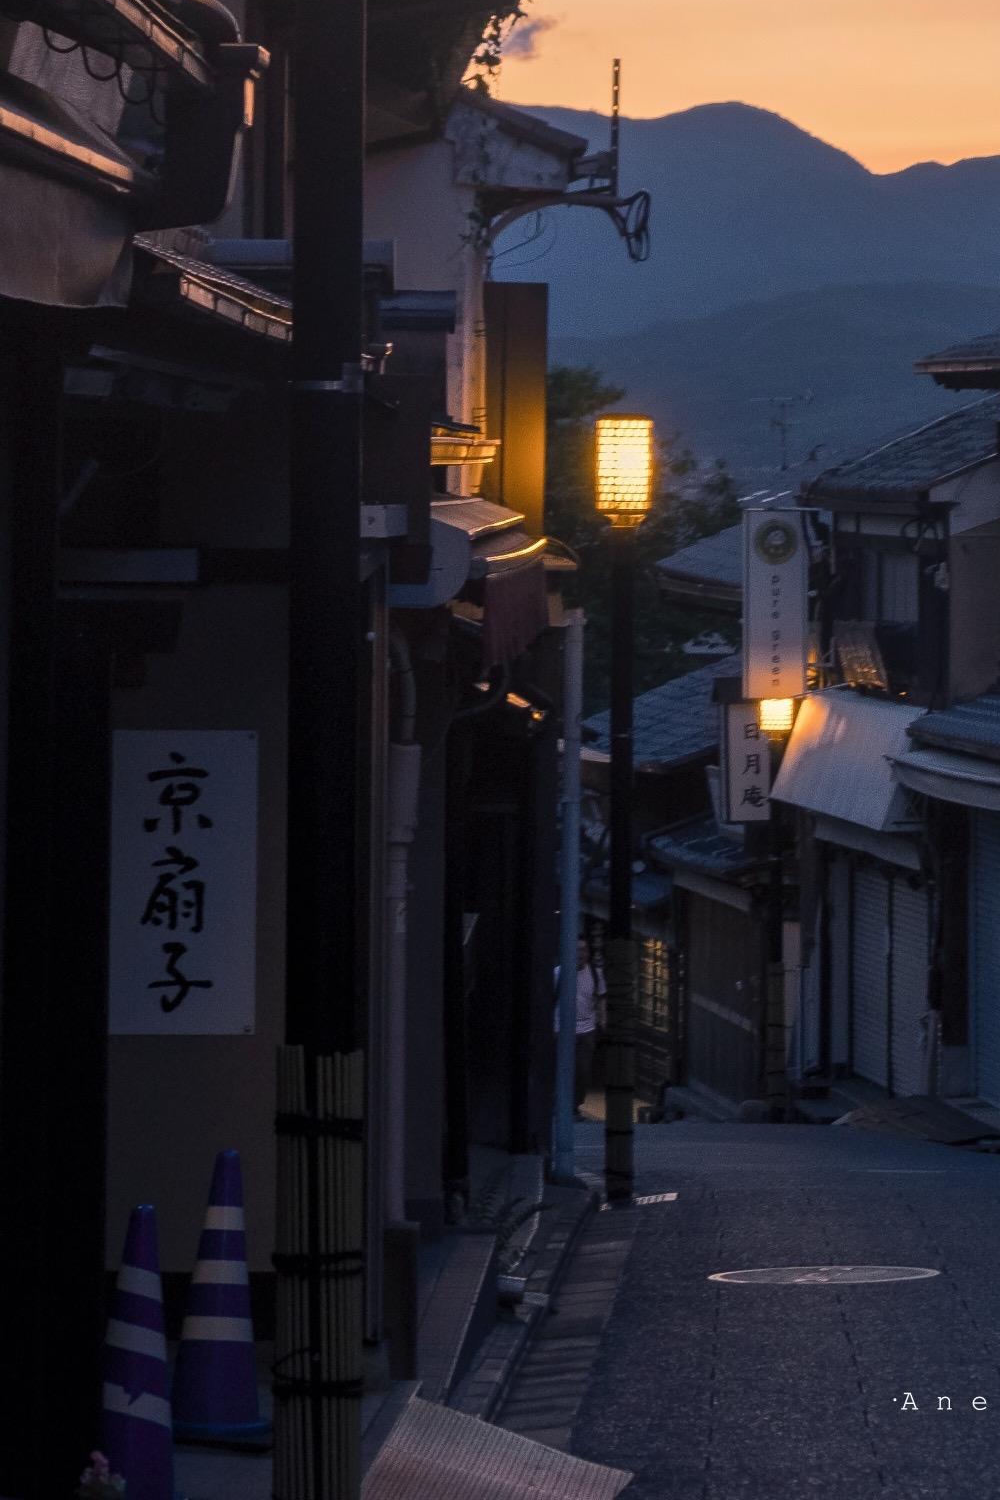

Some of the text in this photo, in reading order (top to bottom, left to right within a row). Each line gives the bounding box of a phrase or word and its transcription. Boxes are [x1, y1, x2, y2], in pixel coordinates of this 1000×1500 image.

[771, 574, 781, 620] pure
[141, 752, 213, 1012] 京扇子
